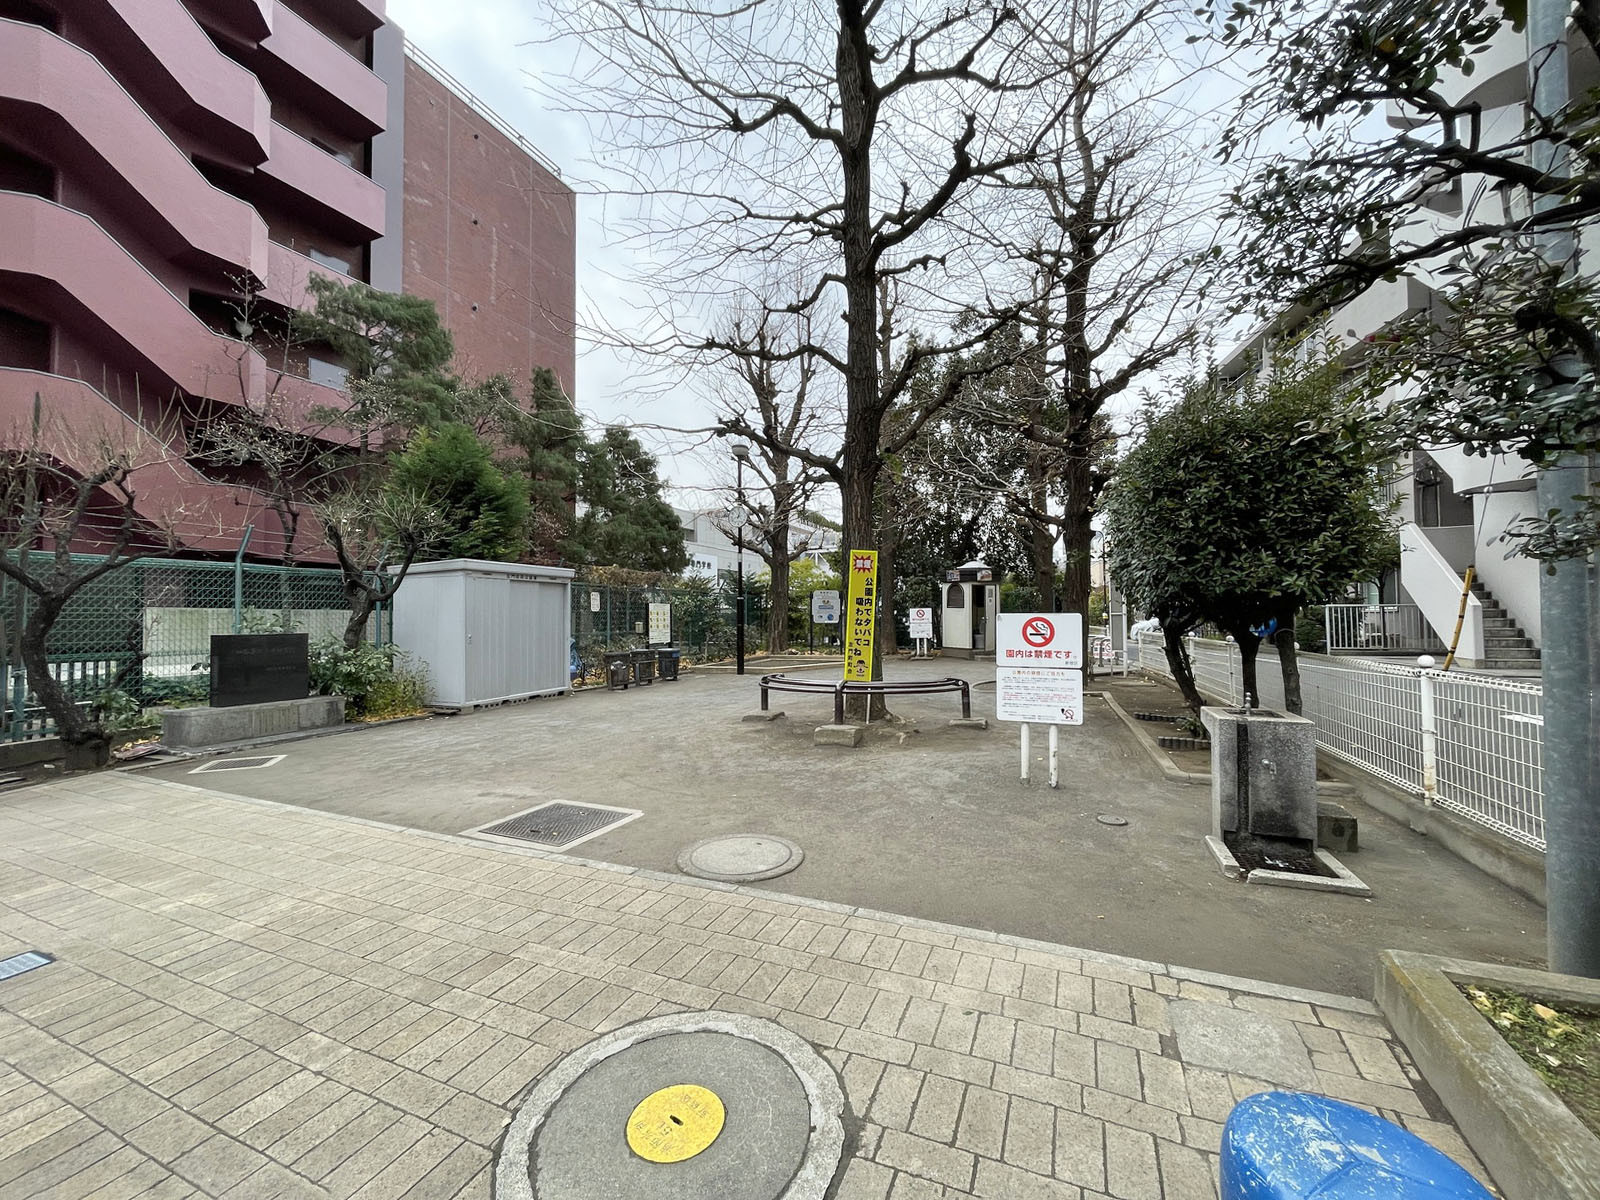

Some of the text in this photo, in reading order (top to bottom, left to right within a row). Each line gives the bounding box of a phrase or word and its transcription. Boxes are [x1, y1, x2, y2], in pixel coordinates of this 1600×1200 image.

[863, 577, 874, 647] 公園内でタバコ
